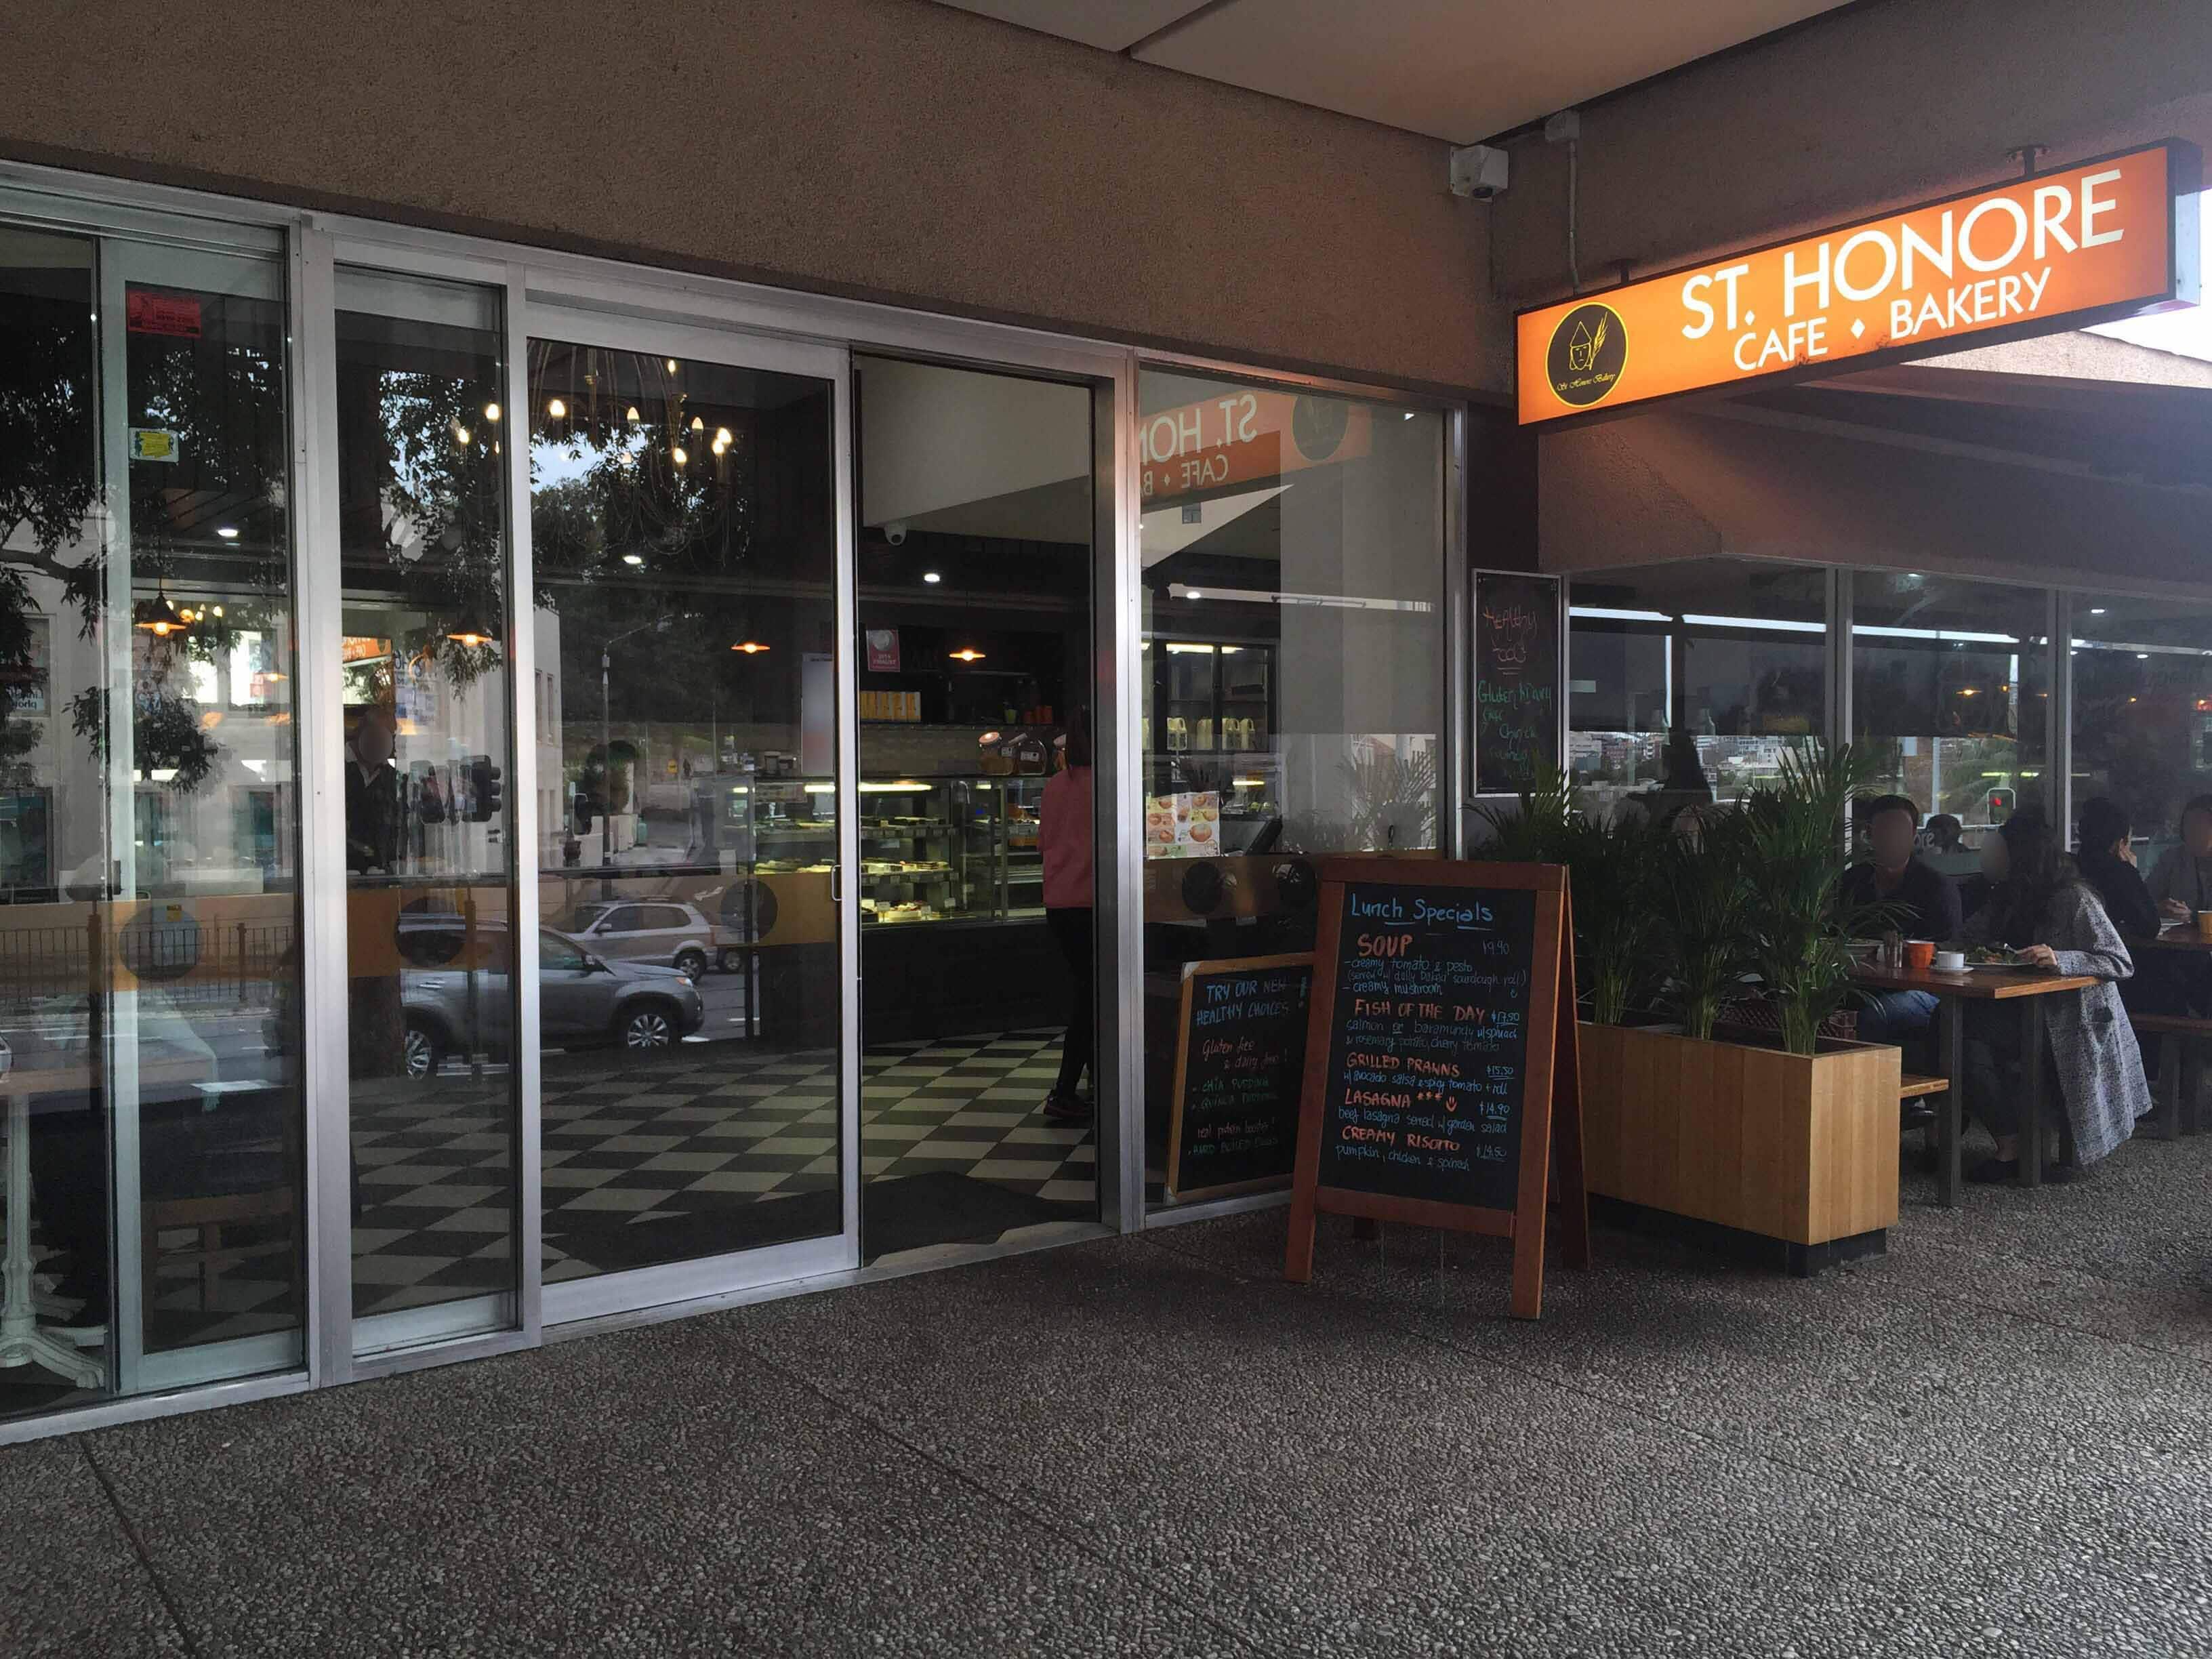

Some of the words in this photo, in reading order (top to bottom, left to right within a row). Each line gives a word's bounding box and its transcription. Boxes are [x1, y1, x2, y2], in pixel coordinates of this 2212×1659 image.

[1681, 263, 1756, 339] ST.
[1784, 169, 2125, 317] HONORE
[1734, 316, 1828, 371] CAFE
[1889, 266, 2051, 340] BAKERY
[1351, 893, 1404, 919] Lunch
[1412, 899, 1494, 926] Specials
[1357, 933, 1414, 958] SOUP
[1391, 954, 1430, 970] tomato
[1446, 958, 1473, 976] pesto
[1206, 981, 1231, 1004] TRY
[1235, 979, 1258, 998] OUR
[1196, 1000, 1244, 1025] HEALTHY
[1345, 1017, 1384, 1031] salmon
[1355, 998, 1391, 1018] FISH
[1398, 1002, 1416, 1019] OF
[1418, 1002, 1443, 1019] THE
[1452, 1004, 1486, 1025] DAY
[1346, 1051, 1401, 1069] GRILLED
[1406, 1057, 1461, 1078] PRAWNS
[1391, 1073, 1416, 1087] salsa
[1448, 1078, 1483, 1093] tomato
[1345, 1086, 1412, 1109] LASAGNA
[1338, 1106, 1360, 1124] beef
[1480, 1122, 1508, 1134] salad
[1341, 1124, 1396, 1147] CREAMY
[1406, 1132, 1461, 1151] RISOTTO
